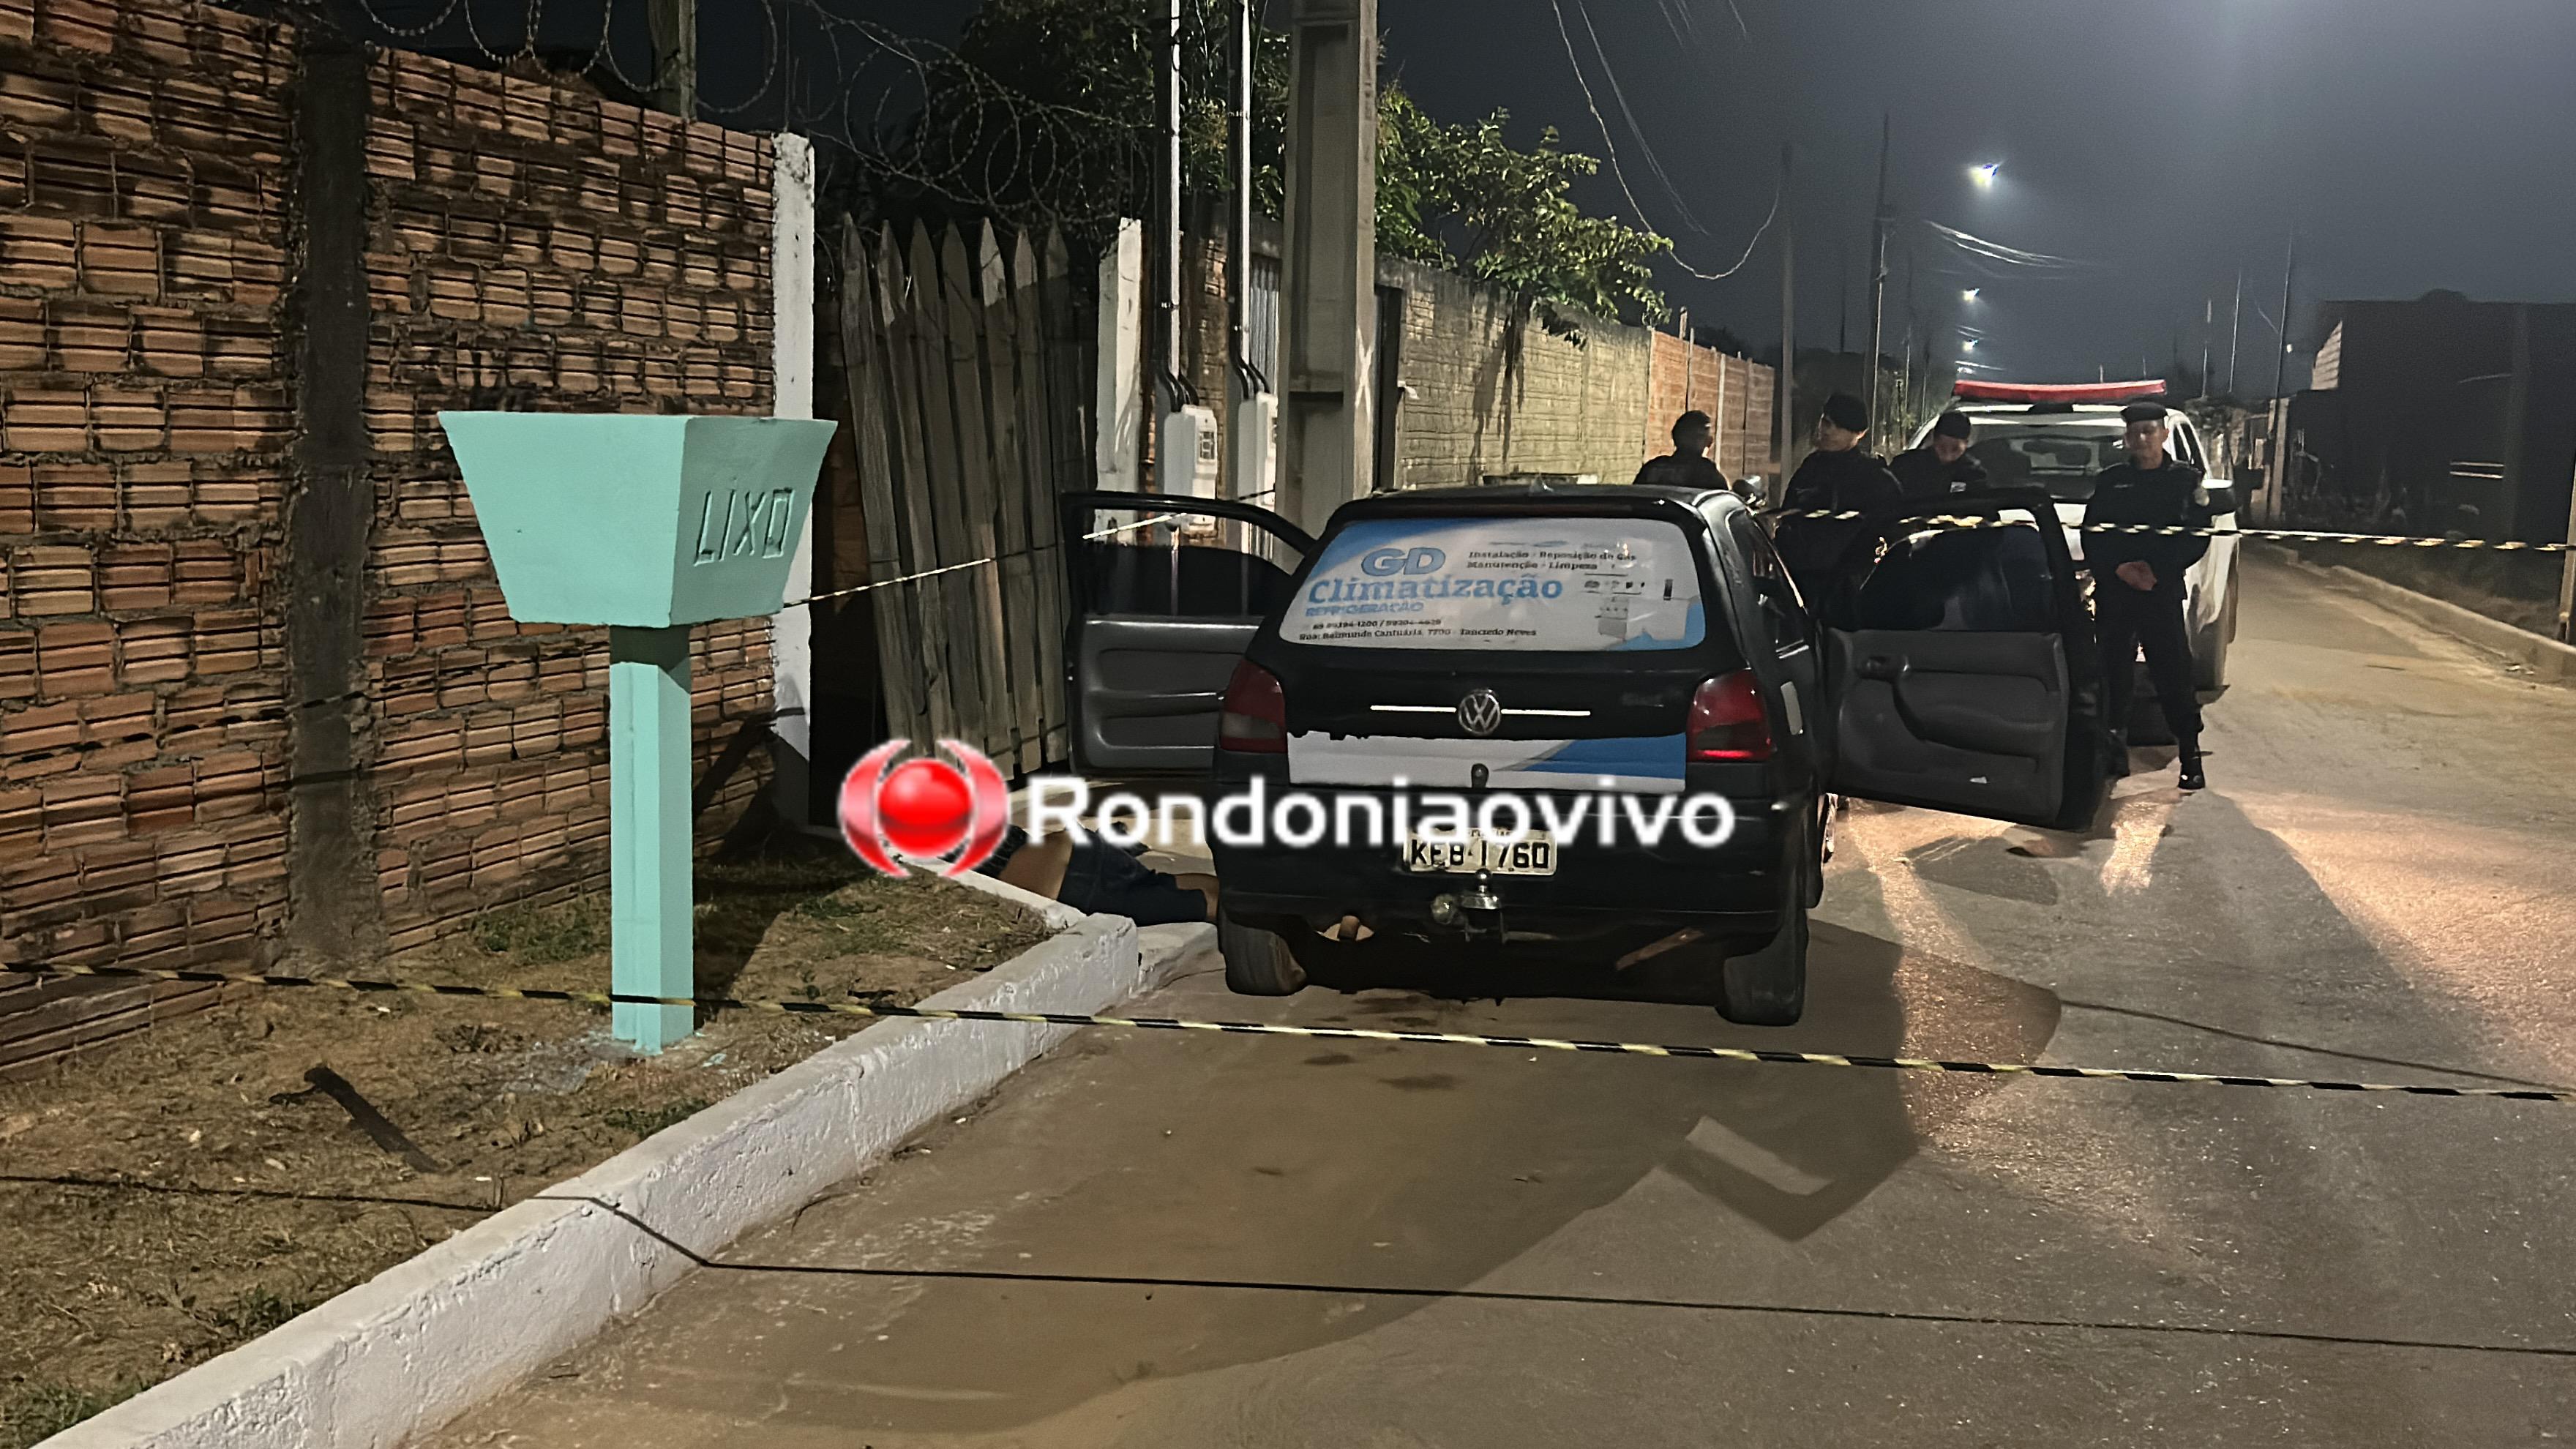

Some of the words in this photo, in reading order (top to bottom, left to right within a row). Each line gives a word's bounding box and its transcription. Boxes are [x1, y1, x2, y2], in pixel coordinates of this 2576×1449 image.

[694, 487, 795, 566] LIXO
[1361, 547, 1447, 577] GD
[1308, 573, 1563, 606] Climatização
